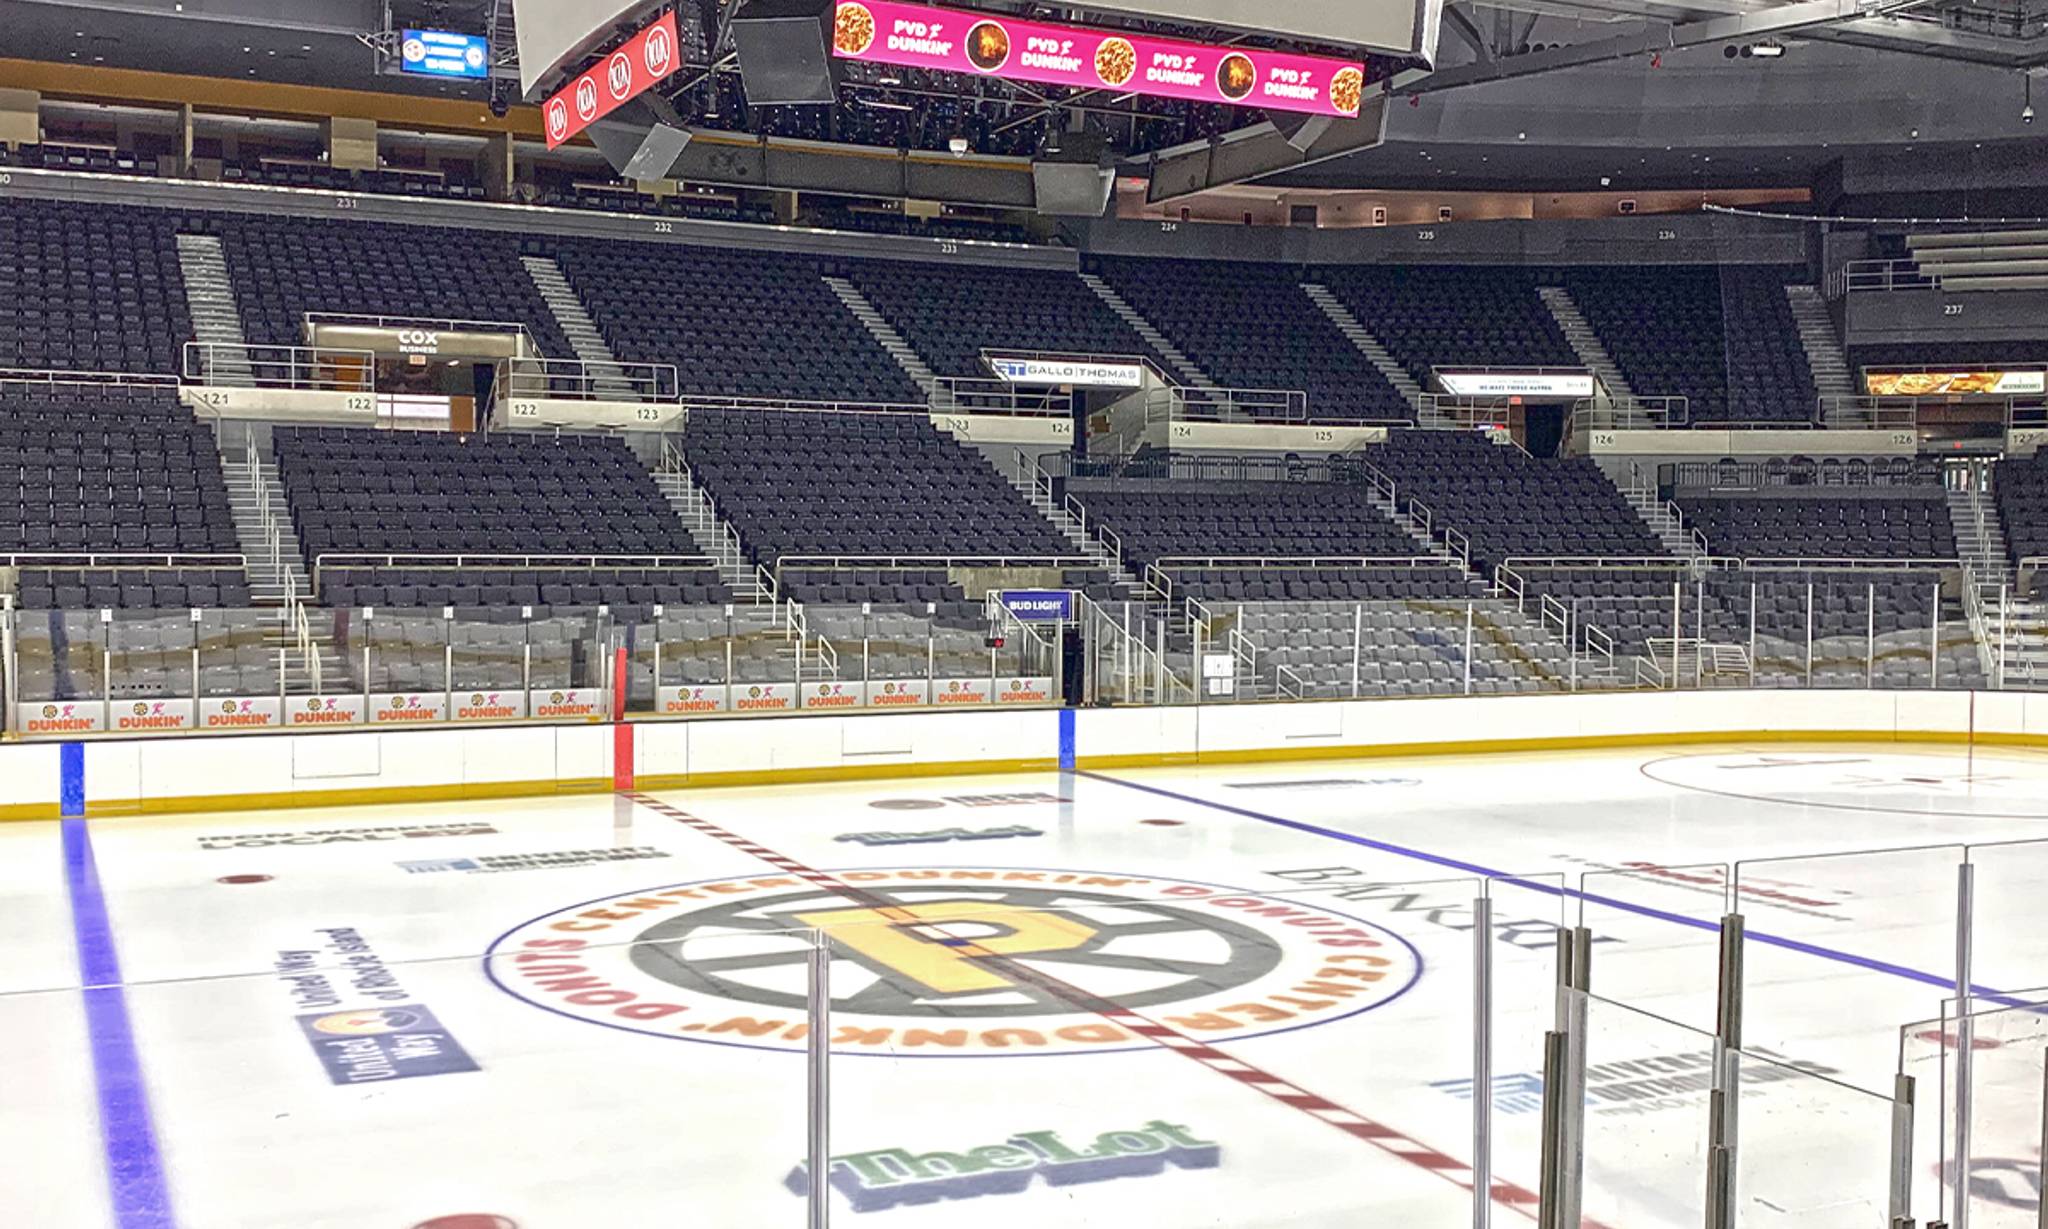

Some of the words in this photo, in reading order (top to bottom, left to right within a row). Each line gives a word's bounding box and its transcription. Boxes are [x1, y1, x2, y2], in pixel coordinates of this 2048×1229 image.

[894, 20, 926, 36] PVD
[888, 36, 953, 57] DUNKIN'
[1027, 37, 1060, 54] PVD
[1021, 52, 1083, 73] DUNKIN'
[1153, 52, 1182, 69] PVD
[1147, 68, 1204, 87] DUNKIN'
[1271, 68, 1297, 84] PVD
[1264, 82, 1318, 101] DUNKIN'
[336, 197, 357, 208] 231
[654, 221, 672, 233] 232
[941, 243, 957, 254] 233
[1944, 304, 1963, 315] 237
[398, 330, 438, 345] COX
[399, 345, 437, 354] BUSINESS
[1027, 364, 1073, 376] GALLO
[1079, 367, 1136, 379] THOMAS
[202, 393, 229, 405] 121
[347, 398, 372, 410] 122
[514, 404, 538, 416] 122
[637, 409, 659, 421] 123
[1052, 423, 1070, 433] 124
[1173, 426, 1191, 437] 124
[1315, 431, 1333, 441] 125
[1595, 434, 1614, 445] 126
[1893, 434, 1912, 445] 126
[1009, 600, 1031, 610] BUD
[1033, 600, 1062, 611] LIGHT
[807, 695, 857, 707] DUNKIN'
[873, 694, 921, 705] DUNKIN'
[938, 692, 984, 703] DUNKIN'
[1001, 691, 1046, 702] DUNKIN'
[537, 704, 594, 716] DUNKIN'
[667, 700, 719, 712] DUNKIN'
[737, 698, 788, 710] DUNKIN'
[294, 711, 356, 723] DUNKIN'
[377, 708, 438, 721] DUNKIN'
[458, 706, 516, 718] DUNKIN'
[27, 718, 95, 731] DUNKIN'
[119, 715, 184, 728] DUNKIN'
[208, 713, 272, 727] DUNKIN'
[197, 833, 293, 842] IRON
[304, 822, 491, 836] WORKERS
[201, 833, 397, 850] LOCAL
[842, 869, 1152, 886] DUNKIN'
[549, 877, 798, 931] CENTER
[1160, 885, 1382, 948] DONUTS
[514, 938, 690, 1020] DONUTS
[278, 974, 342, 1009] United
[1164, 953, 1392, 1031] CENTER
[681, 1016, 1131, 1047] DUNKIN'
[389, 1033, 444, 1061] Way
[325, 1037, 398, 1082] United
